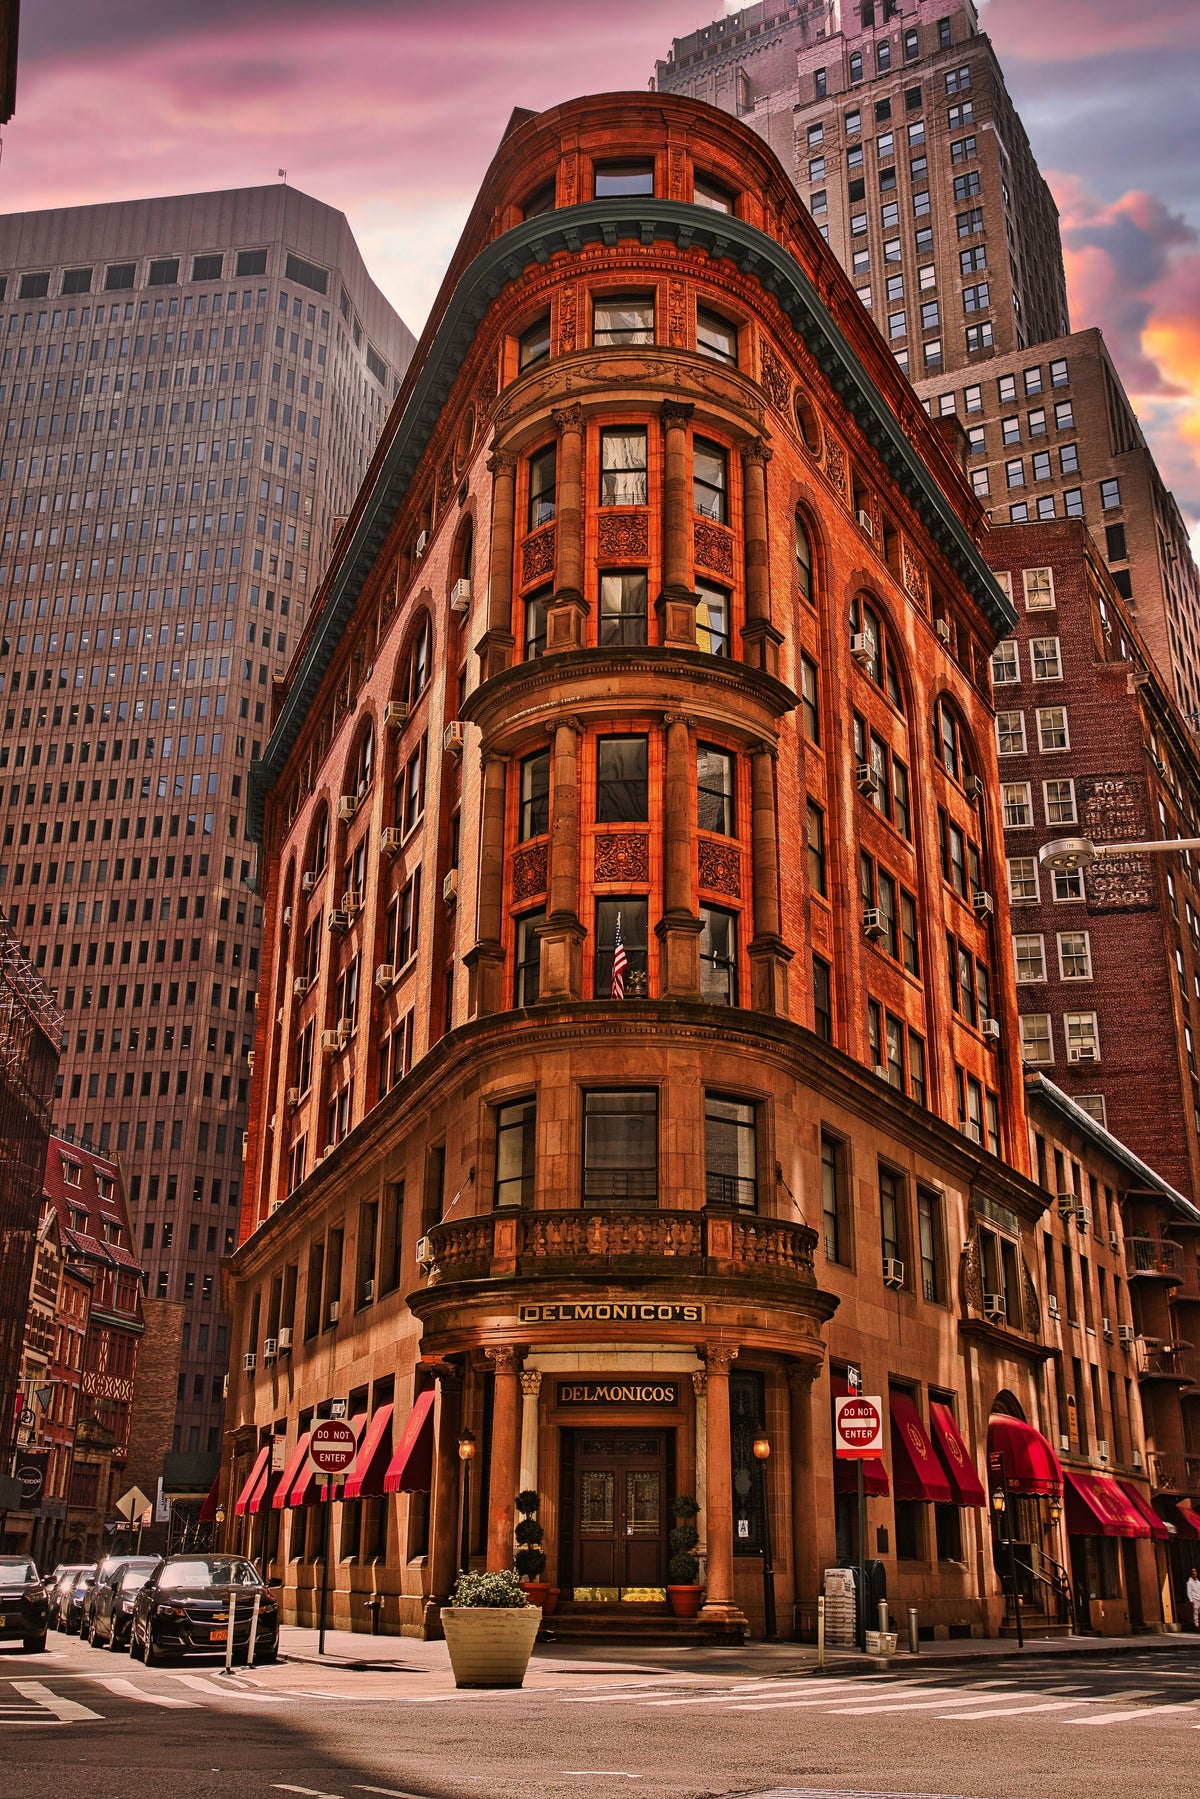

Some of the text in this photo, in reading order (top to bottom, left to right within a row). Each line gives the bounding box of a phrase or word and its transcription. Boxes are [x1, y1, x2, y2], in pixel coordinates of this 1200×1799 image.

[524, 1304, 698, 1321] DELMONICO'S
[561, 1386, 675, 1401] DELMONICOS
[844, 1408, 873, 1416] DO NOT
[317, 1430, 350, 1439] DO NOT
[845, 1429, 873, 1439] ENTER
[319, 1453, 346, 1462] ENTER
[1008, 1479, 1020, 1487] 56
